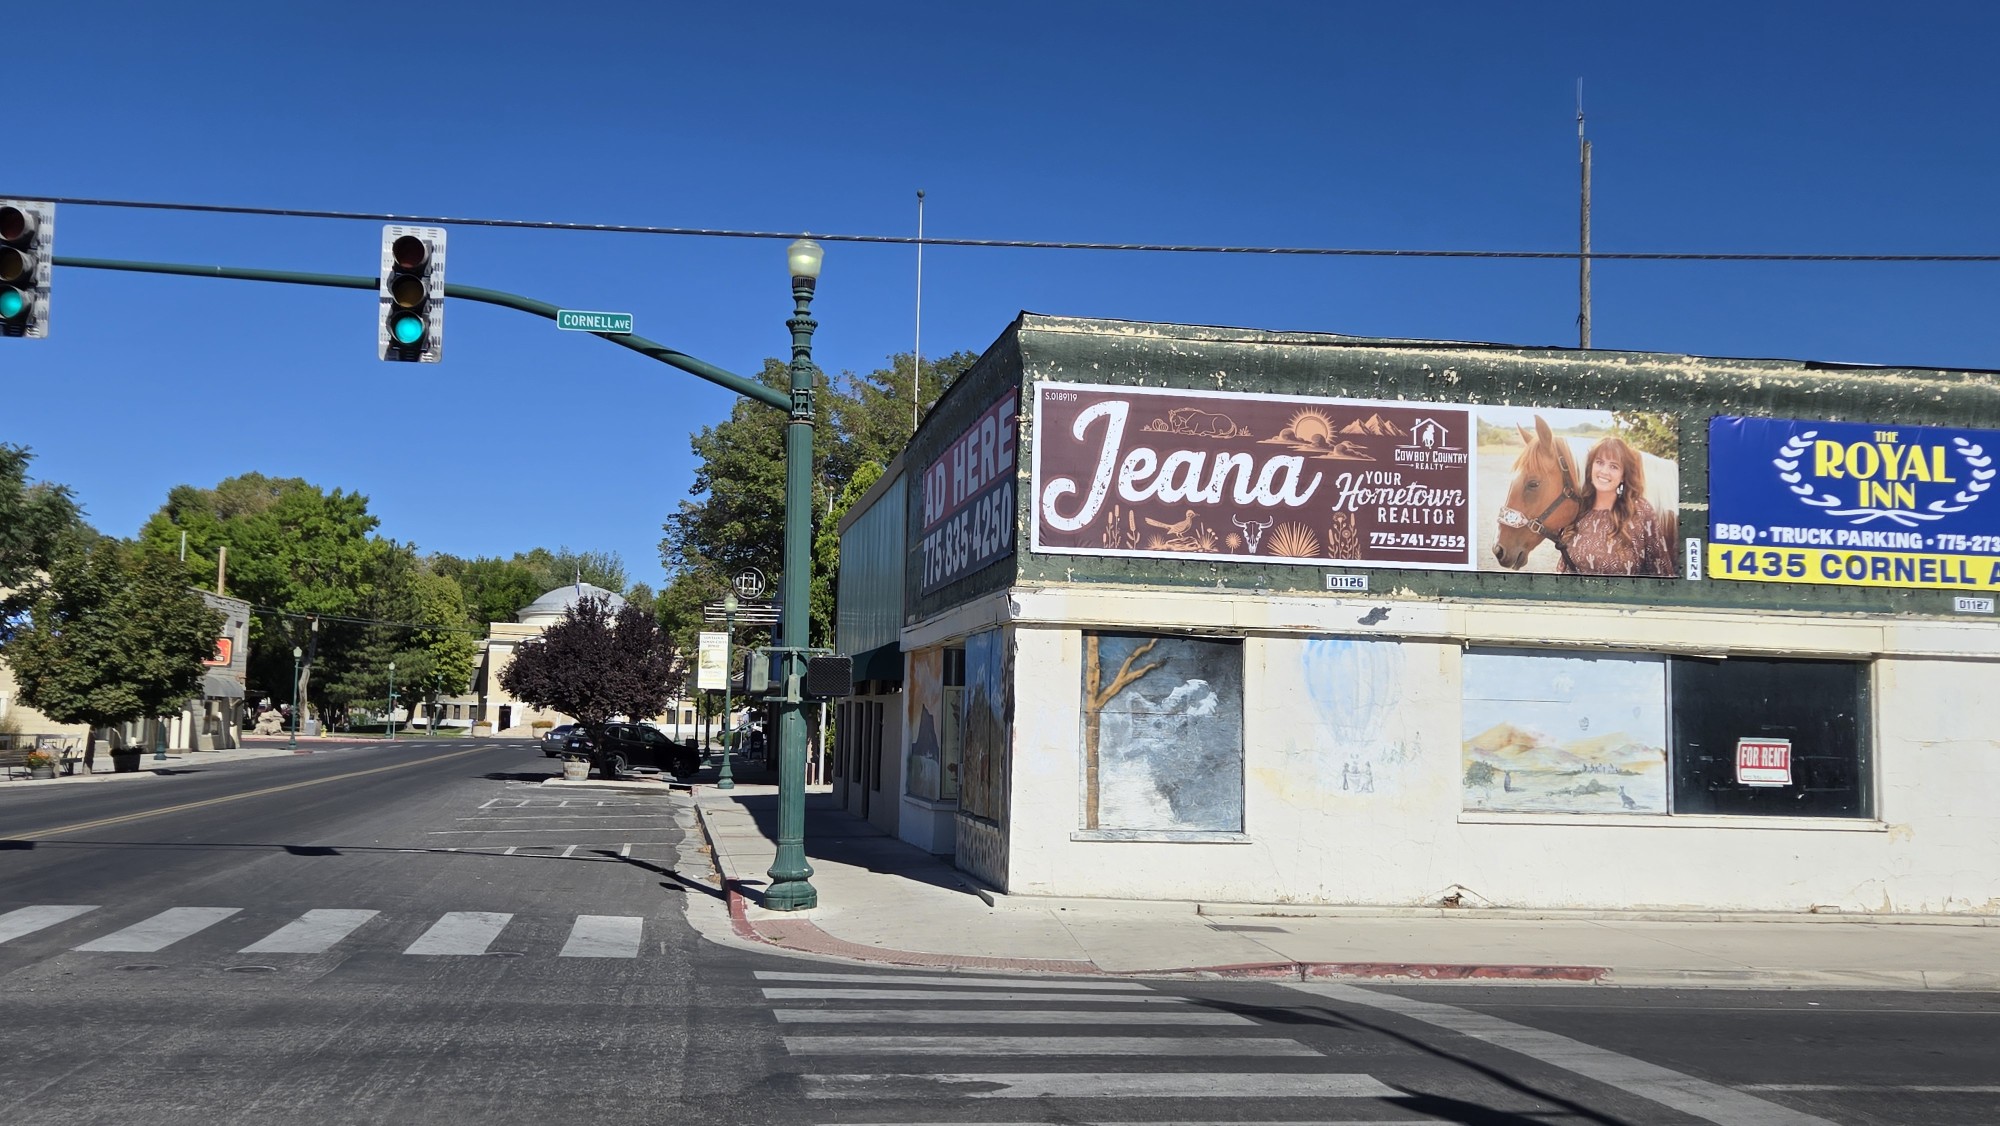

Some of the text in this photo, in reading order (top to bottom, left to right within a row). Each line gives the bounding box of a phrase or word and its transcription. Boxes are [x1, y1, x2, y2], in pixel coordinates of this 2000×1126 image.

[564, 314, 630, 329] CORNELL AVE
[1045, 392, 1078, 402] S.0189119
[1874, 430, 1899, 443] THE
[924, 396, 1015, 529] AD HERE
[1043, 400, 1322, 531] Jeana
[1394, 449, 1468, 464] COWBOY COUNTRY
[1415, 463, 1444, 471] REALTY
[1815, 439, 1957, 483] ROYAL
[1365, 471, 1402, 486] YOUR
[1332, 472, 1466, 512] Hometown
[1859, 480, 1915, 510] INN
[1377, 507, 1455, 525] REALTOR
[1370, 532, 1466, 548] 775-741-7552
[1715, 523, 1756, 544] BBQ
[1770, 526, 1834, 546] TRUCK
[1837, 529, 1923, 550] PARKING
[1690, 541, 1698, 578] ARENA
[1721, 550, 1807, 578] 1435
[1820, 553, 1977, 585] CORNELL
[1741, 746, 1787, 767] FOR RENT
